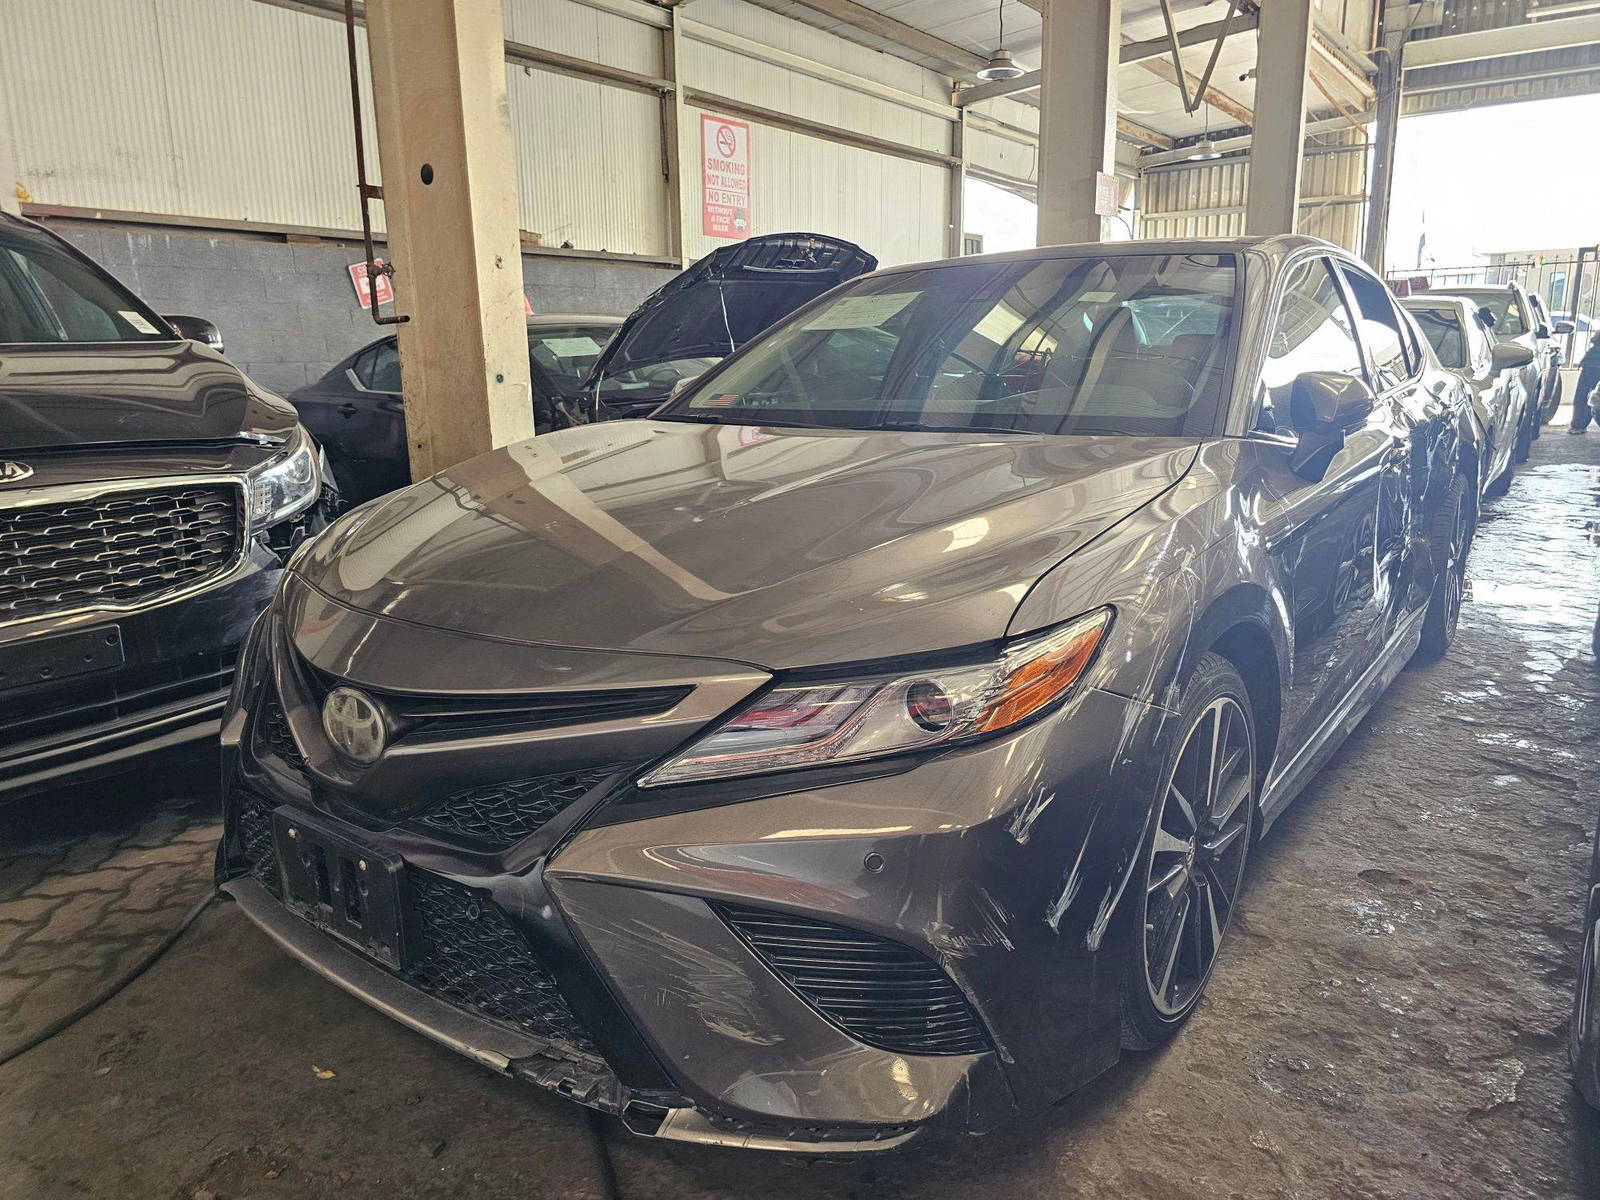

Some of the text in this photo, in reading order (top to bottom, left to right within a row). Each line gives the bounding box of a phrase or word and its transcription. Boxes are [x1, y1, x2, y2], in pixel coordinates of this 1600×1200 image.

[707, 158, 746, 176] SMOKING
[706, 173, 720, 186] NOT
[708, 191, 746, 207] NO ENTRY
